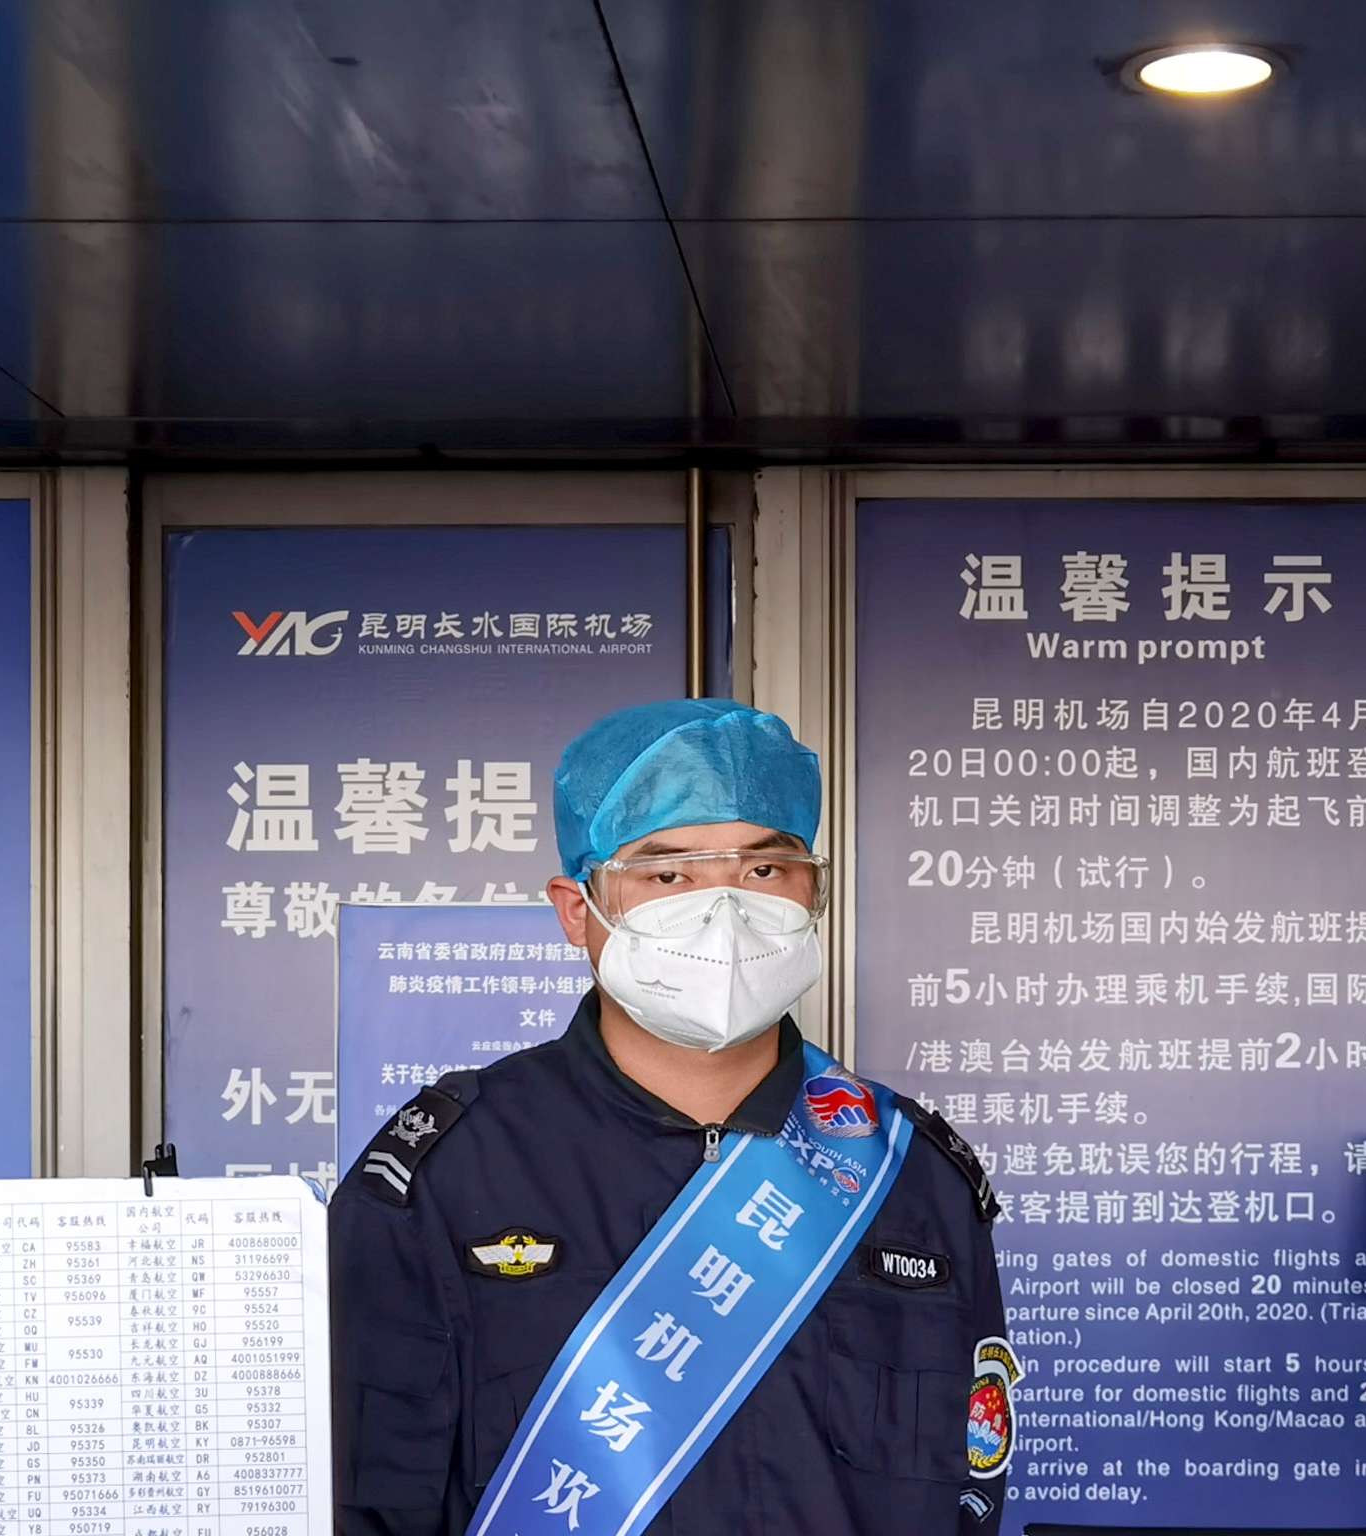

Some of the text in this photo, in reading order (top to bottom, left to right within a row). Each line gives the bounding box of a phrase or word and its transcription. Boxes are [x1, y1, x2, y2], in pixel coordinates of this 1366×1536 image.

[959, 550, 1332, 623] 温馨提示
[358, 611, 653, 640] 昆明长水国际机场
[358, 643, 653, 655] KUNMING CHANGSHUI INTERNATIONAL AIRPORT
[1026, 632, 1265, 665] Warm prompt
[227, 758, 538, 854] 温馨提
[519, 1008, 556, 1028] 文件
[221, 1068, 336, 1125] 外无
[843, 1157, 868, 1176] ASIA
[22, 1242, 36, 1253] CA
[66, 1240, 101, 1252] 95583
[228, 1236, 297, 1249] 4008680000
[22, 1257, 100, 1269] ZH 95361
[234, 1254, 290, 1265] 31196699
[881, 1251, 937, 1279] WT0034
[994, 1249, 1038, 1272] ding
[1052, 1250, 1112, 1272] gates
[1125, 1248, 1147, 1268] of
[1160, 1249, 1259, 1268] domestic
[1273, 1248, 1340, 1271] flights
[66, 1273, 101, 1285] 95369
[1009, 1277, 1080, 1299] Airport
[1090, 1277, 1124, 1295] will
[1135, 1277, 1161, 1295] be
[1171, 1277, 1240, 1295] closed
[1251, 1274, 1282, 1295] 20
[1005, 1304, 1080, 1326] parture
[1084, 1302, 1140, 1321] since
[1144, 1302, 1193, 1325] April
[1197, 1302, 1250, 1322] 20th,
[1256, 1302, 1313, 1321] 2020.
[194, 1387, 209, 1398] 3U
[246, 1385, 281, 1397] 95378
[195, 1436, 210, 1447] KY
[230, 1435, 296, 1447] 0871-96598
[233, 1467, 303, 1480] 4008337777
